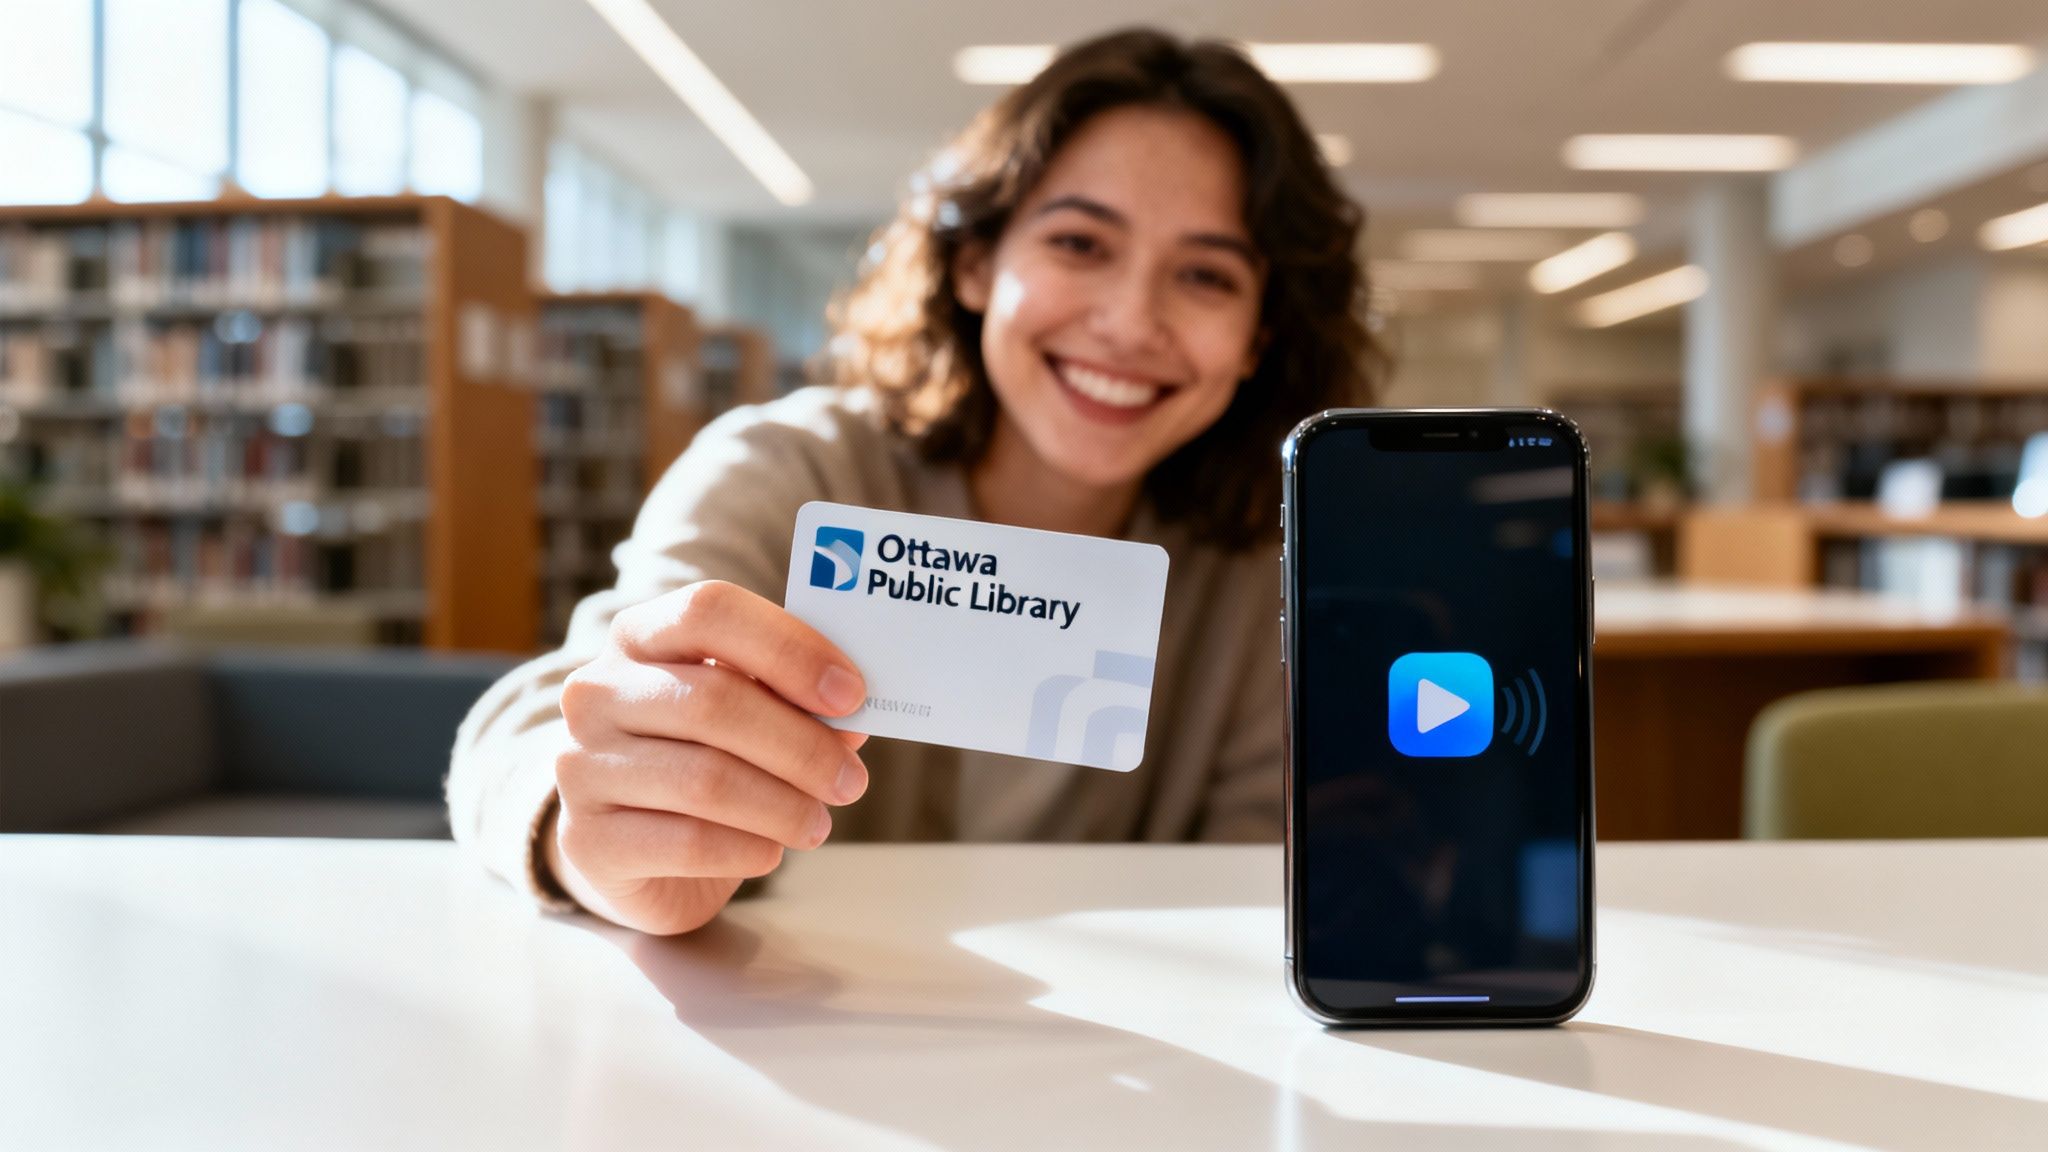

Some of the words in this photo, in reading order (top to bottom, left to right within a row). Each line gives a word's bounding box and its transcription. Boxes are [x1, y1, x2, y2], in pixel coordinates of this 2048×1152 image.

[877, 533, 998, 577] Ottawa
[867, 568, 962, 608] Public
[969, 581, 1081, 630] Library
